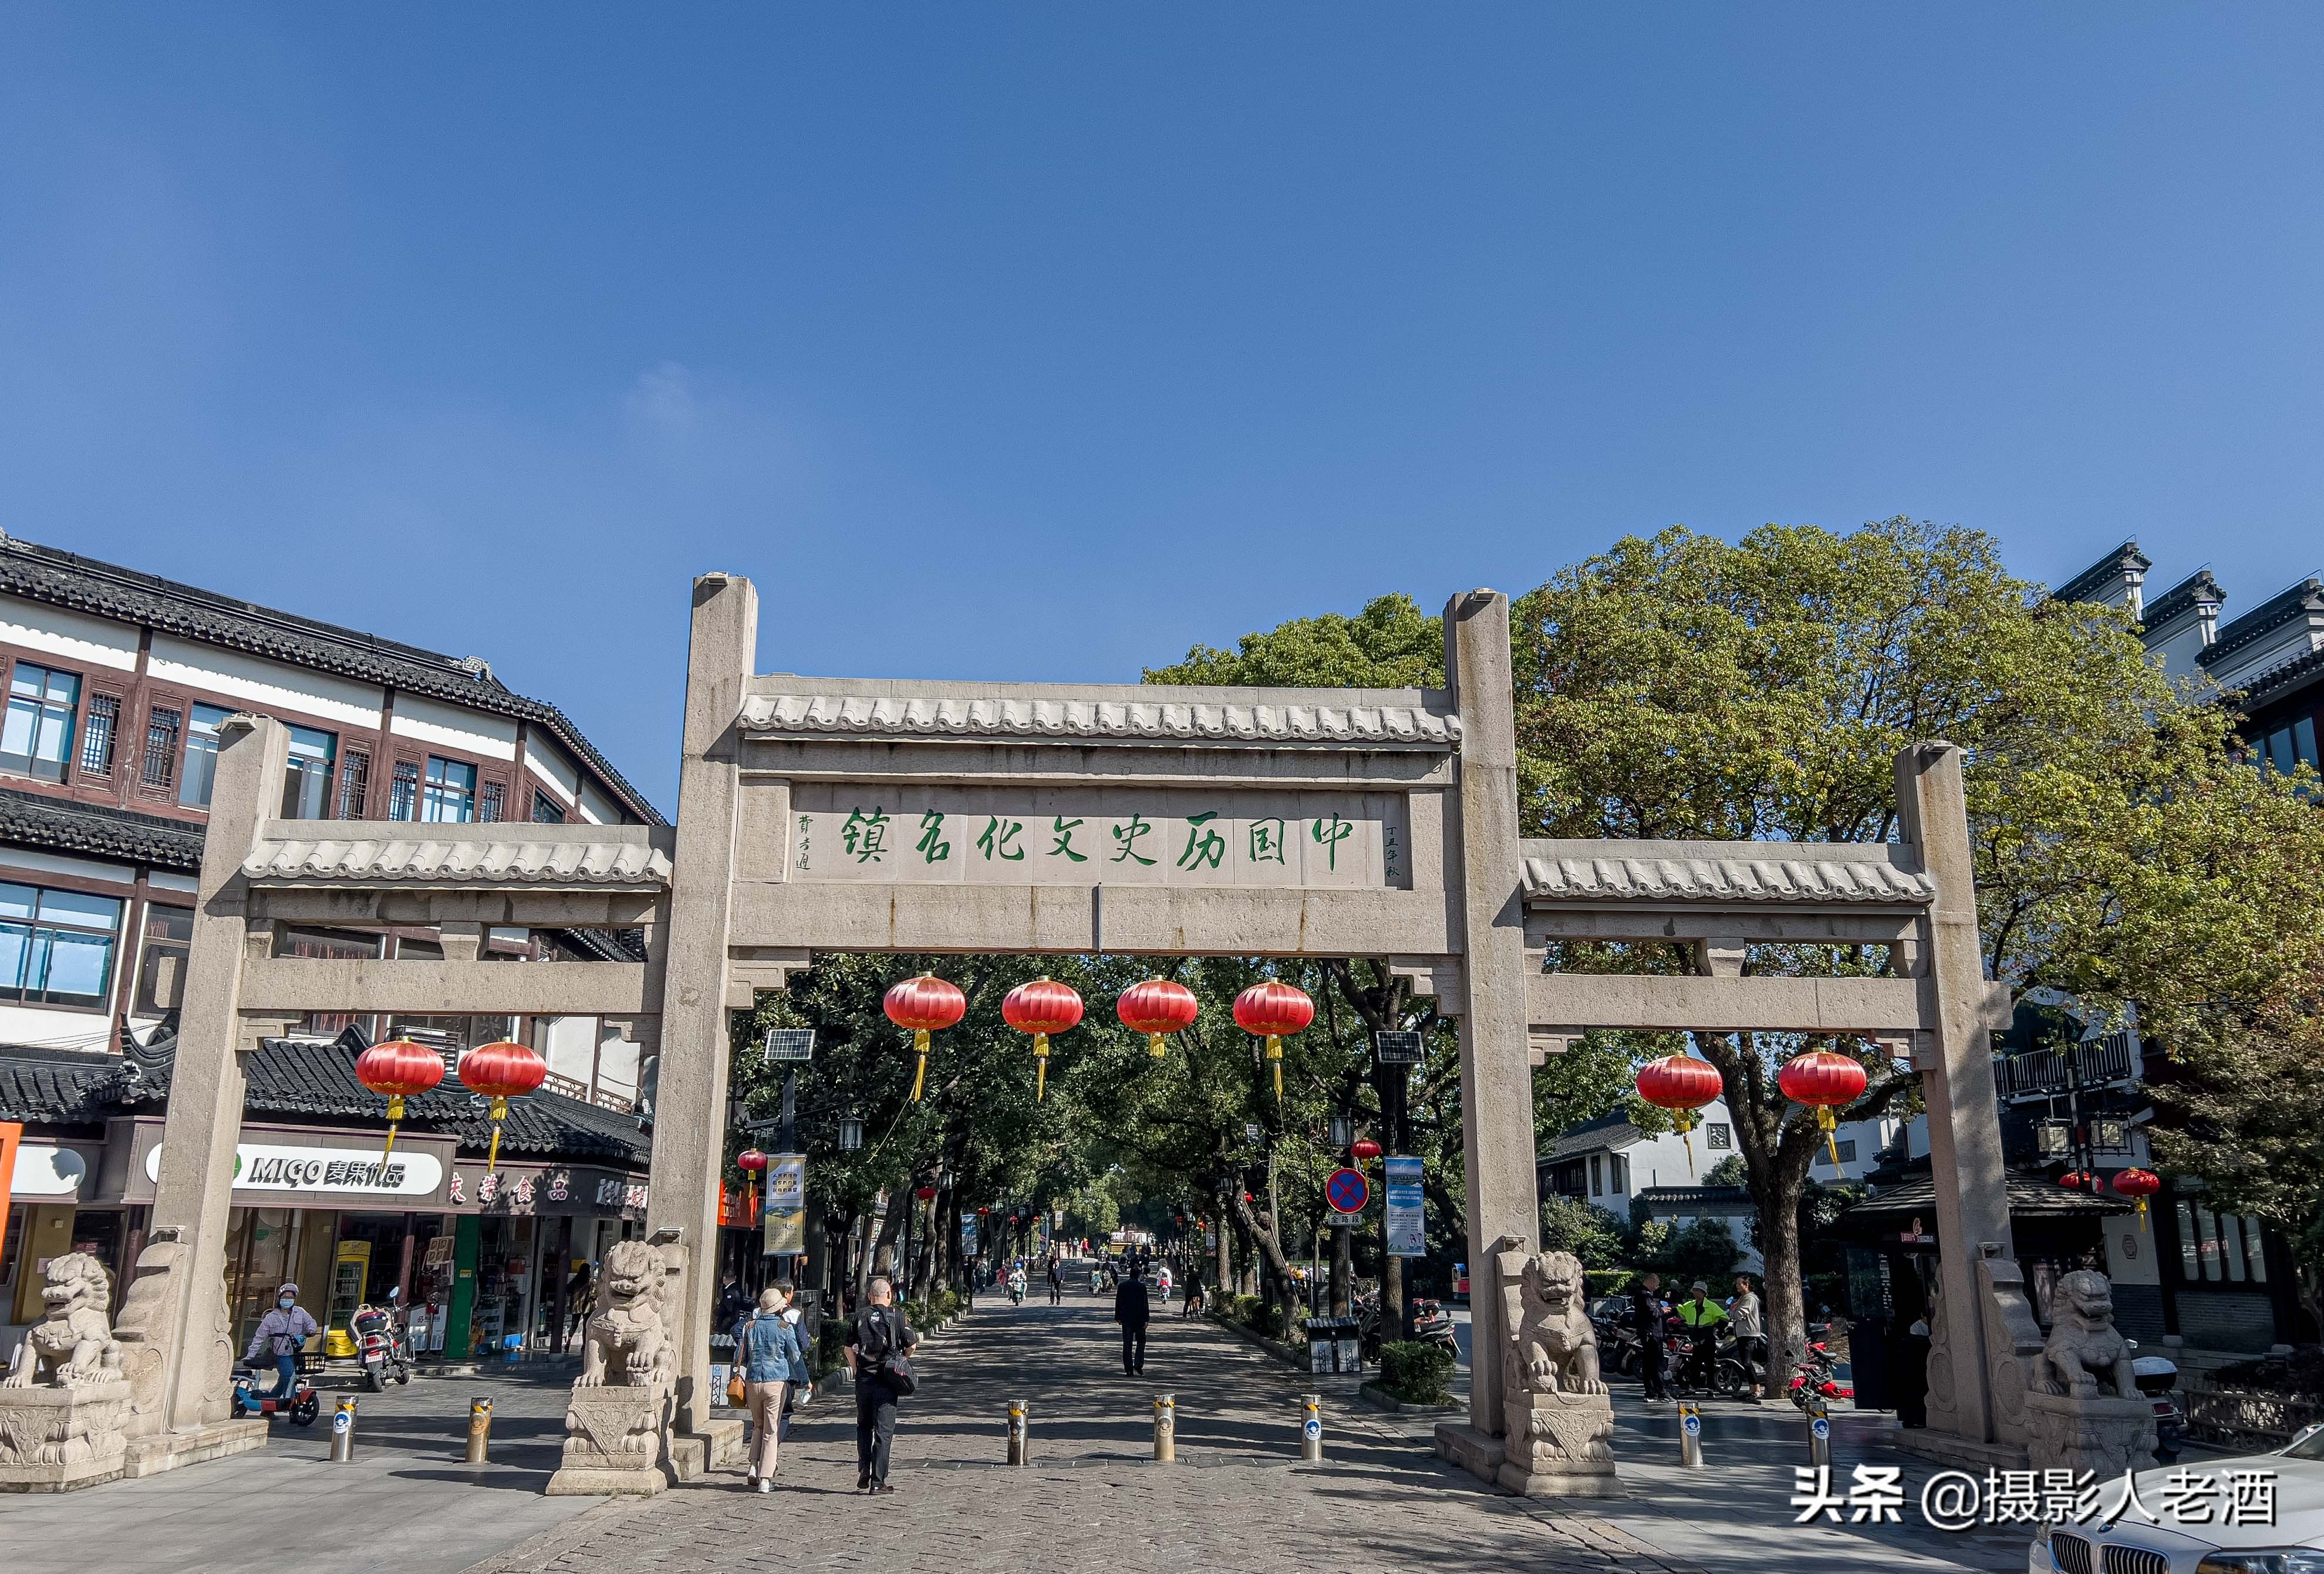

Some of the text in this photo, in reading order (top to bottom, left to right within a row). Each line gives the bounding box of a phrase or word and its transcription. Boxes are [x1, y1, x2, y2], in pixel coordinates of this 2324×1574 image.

[1385, 826, 1400, 878] 丁丑年秋
[249, 1157, 324, 1187] MIGO
[325, 1161, 406, 1188] 麦果优品
[1331, 1215, 1360, 1224] 全路段
